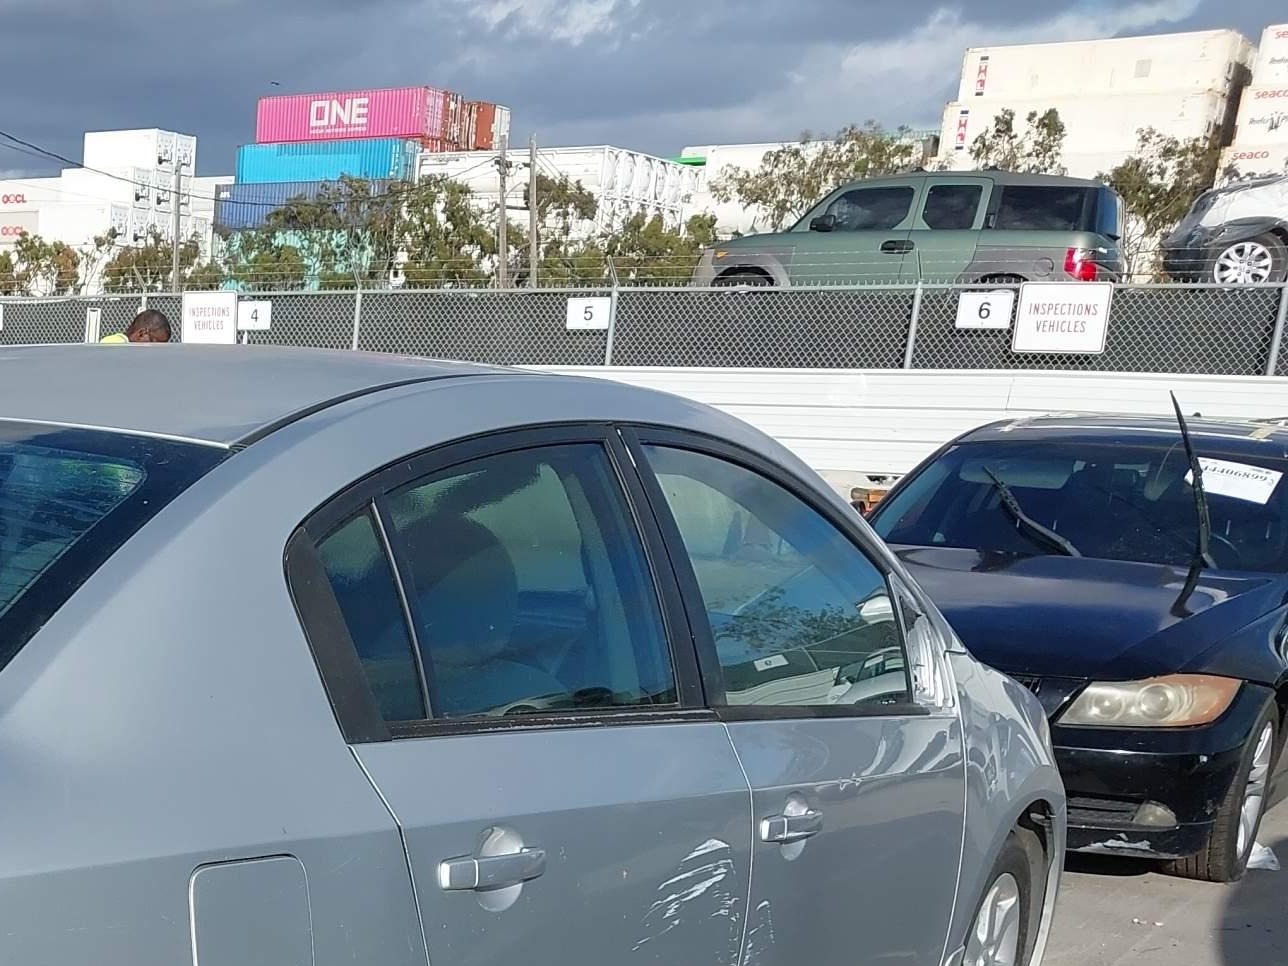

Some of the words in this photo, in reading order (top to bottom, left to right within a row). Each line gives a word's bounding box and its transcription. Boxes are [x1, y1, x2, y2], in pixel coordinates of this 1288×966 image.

[310, 97, 369, 127] ONE
[1232, 151, 1270, 161] seaco
[2, 193, 27, 204] OOCL
[189, 306, 230, 317] INSPECTIONS
[250, 308, 259, 322] 4
[584, 305, 593, 321] 5
[978, 301, 991, 319] 6
[1028, 302, 1098, 317] INSPECTIONS
[193, 320, 224, 330] VEHICLES
[1035, 320, 1087, 333] VEHICLES
